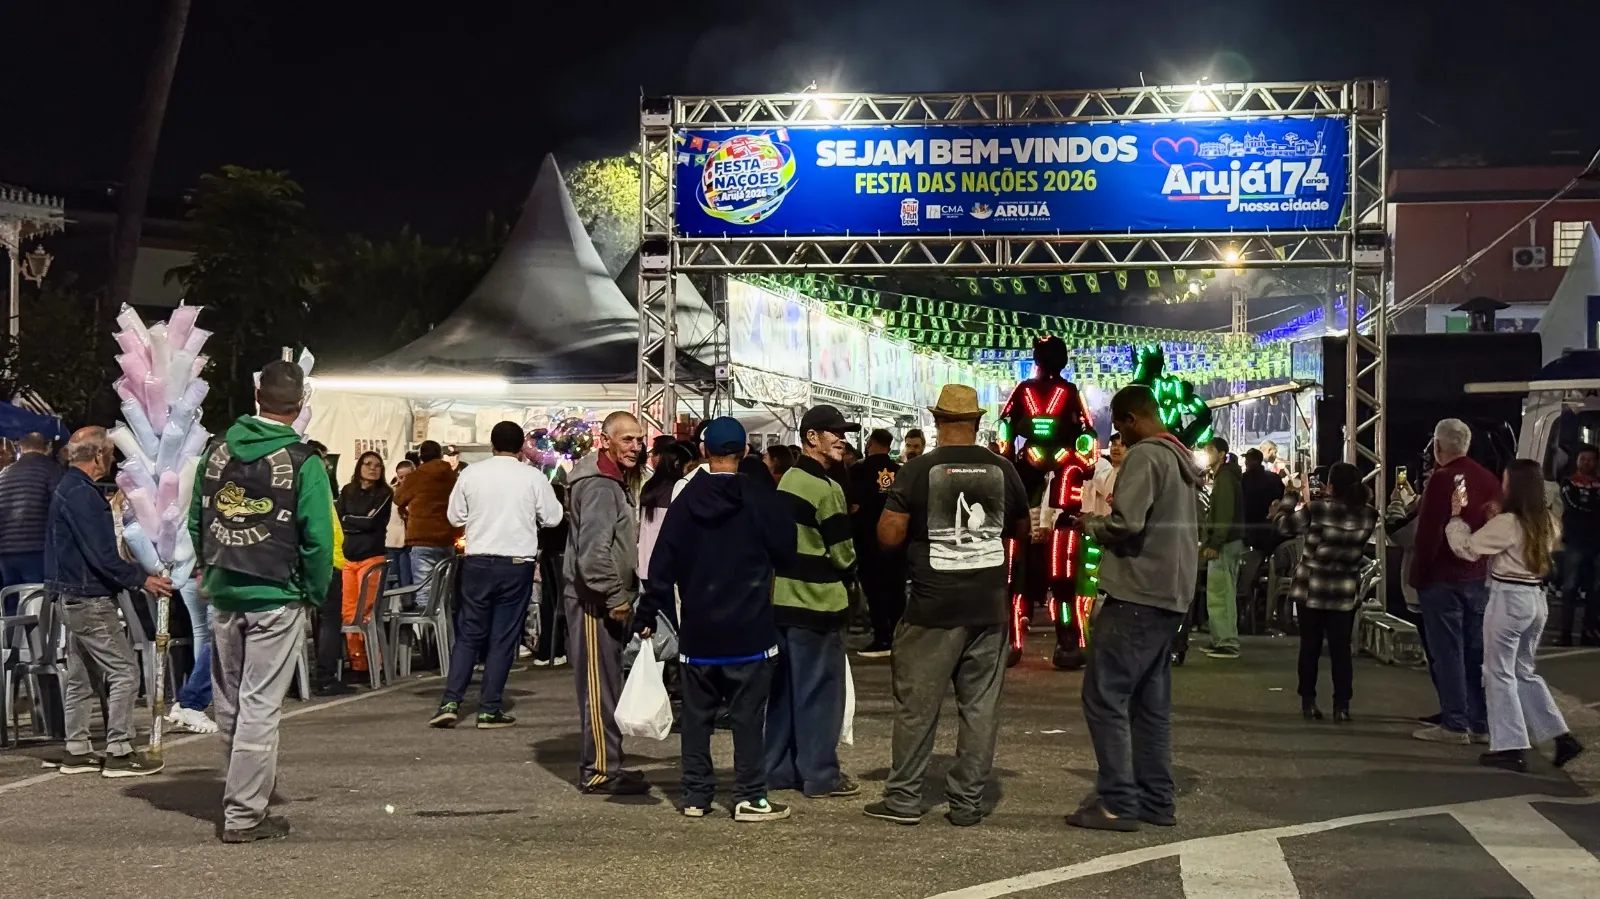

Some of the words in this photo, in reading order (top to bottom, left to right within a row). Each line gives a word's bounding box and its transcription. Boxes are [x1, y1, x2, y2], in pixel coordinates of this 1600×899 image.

[816, 140, 924, 166] SEJAM
[931, 136, 1138, 165] BEM-VINDOS
[714, 158, 761, 174] FESTA
[714, 170, 779, 189] NAÇÕES
[855, 172, 913, 194] FESTA
[918, 171, 956, 193] DAS
[961, 167, 1038, 196] NAÇÕES
[1043, 169, 1097, 192] 2026
[941, 205, 964, 214] CMA
[994, 201, 1051, 217] ARUJÁ
[1239, 202, 1279, 213] nossa
[1280, 198, 1329, 212] cidade
[276, 509, 292, 522] C
